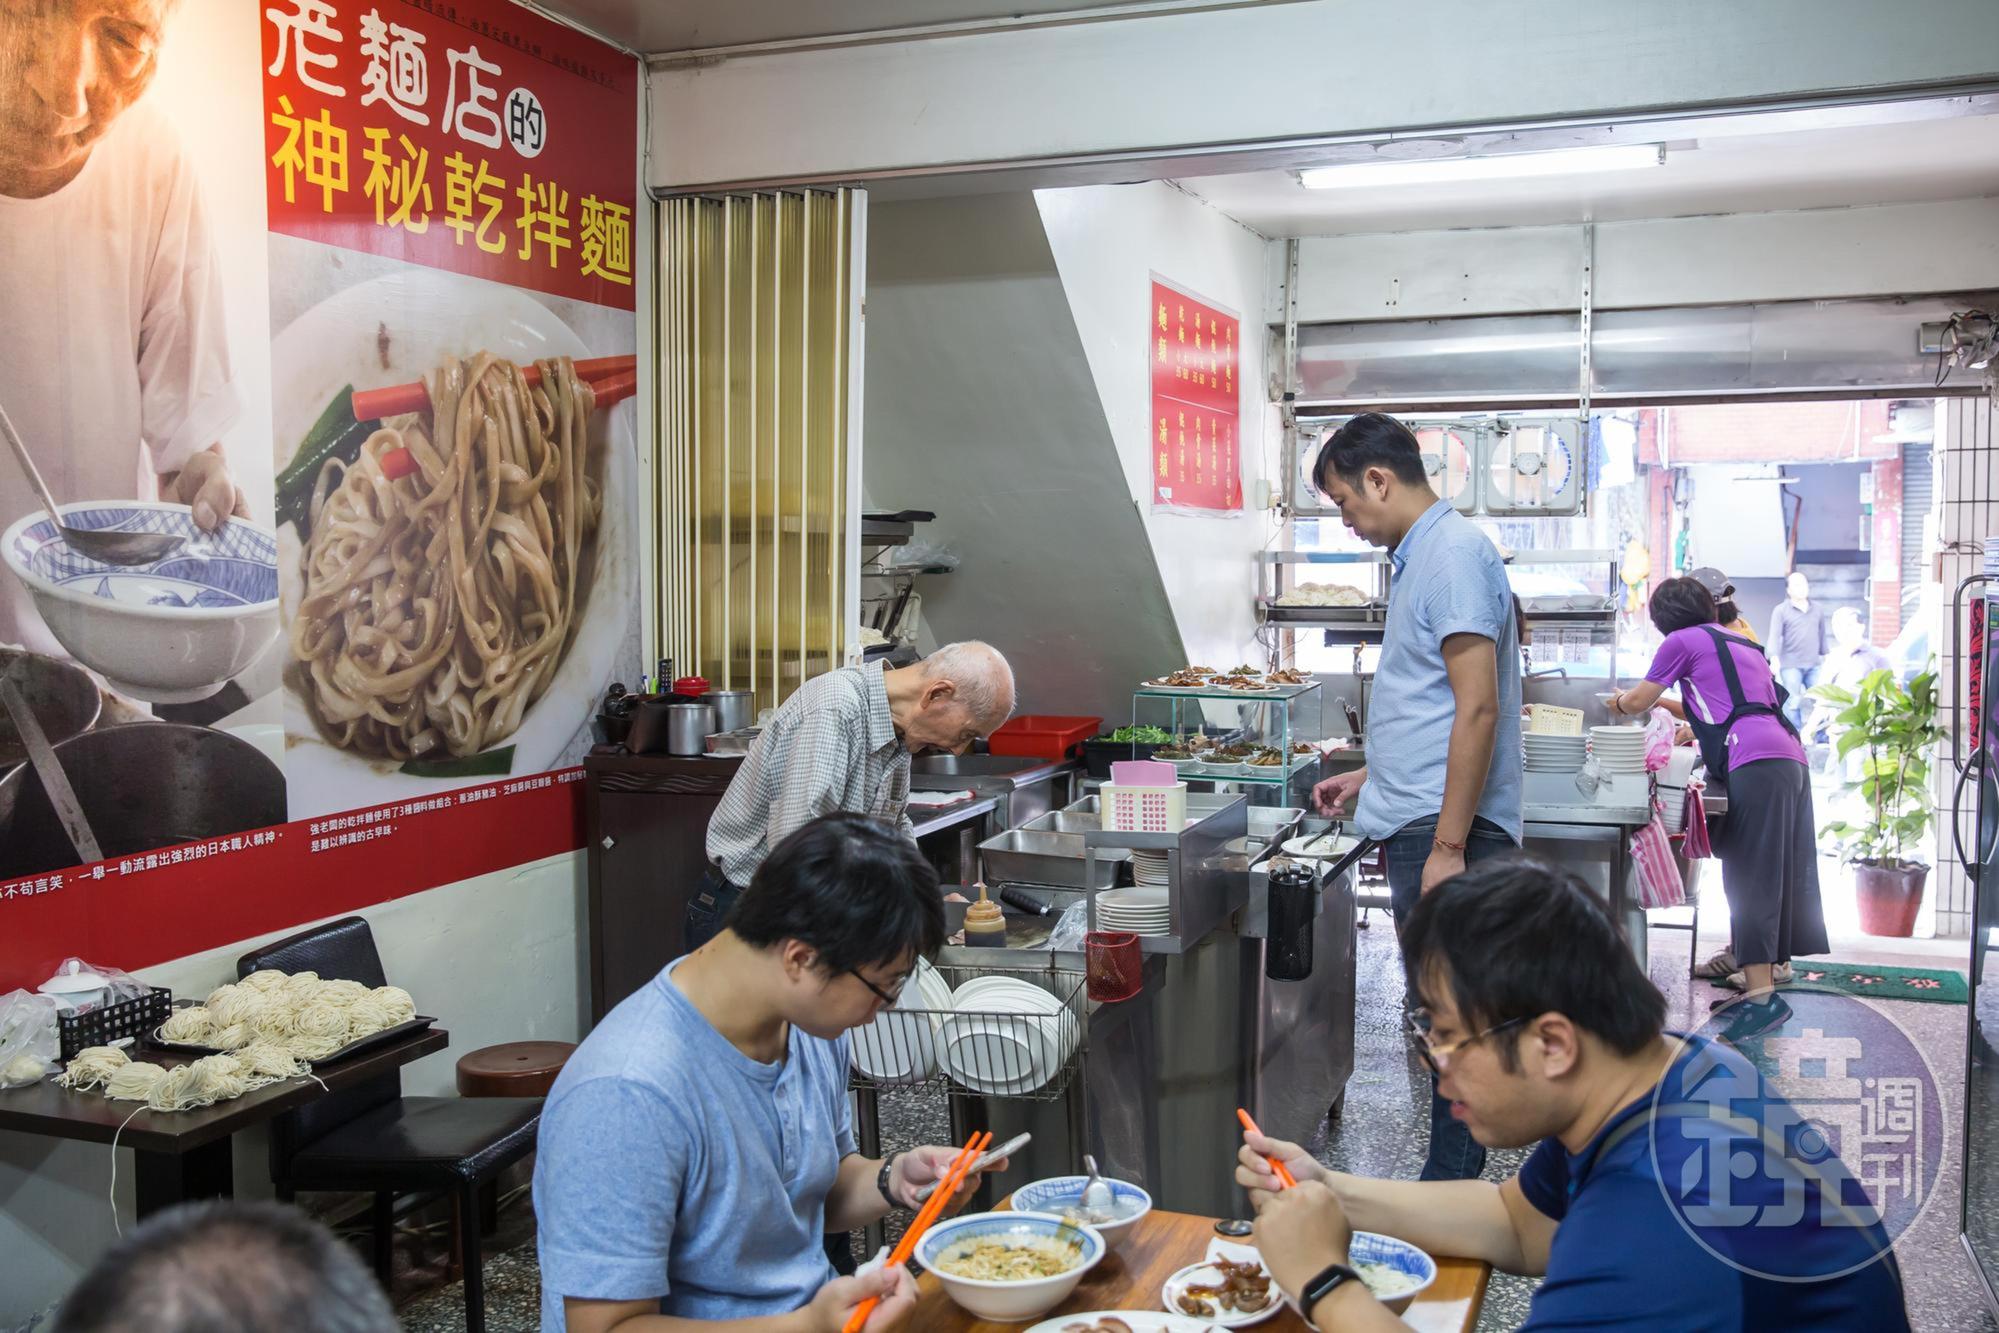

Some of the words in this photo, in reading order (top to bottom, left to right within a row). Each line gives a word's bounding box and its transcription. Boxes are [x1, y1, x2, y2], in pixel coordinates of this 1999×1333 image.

[271, 95, 632, 286] 神秘乾拌麵
